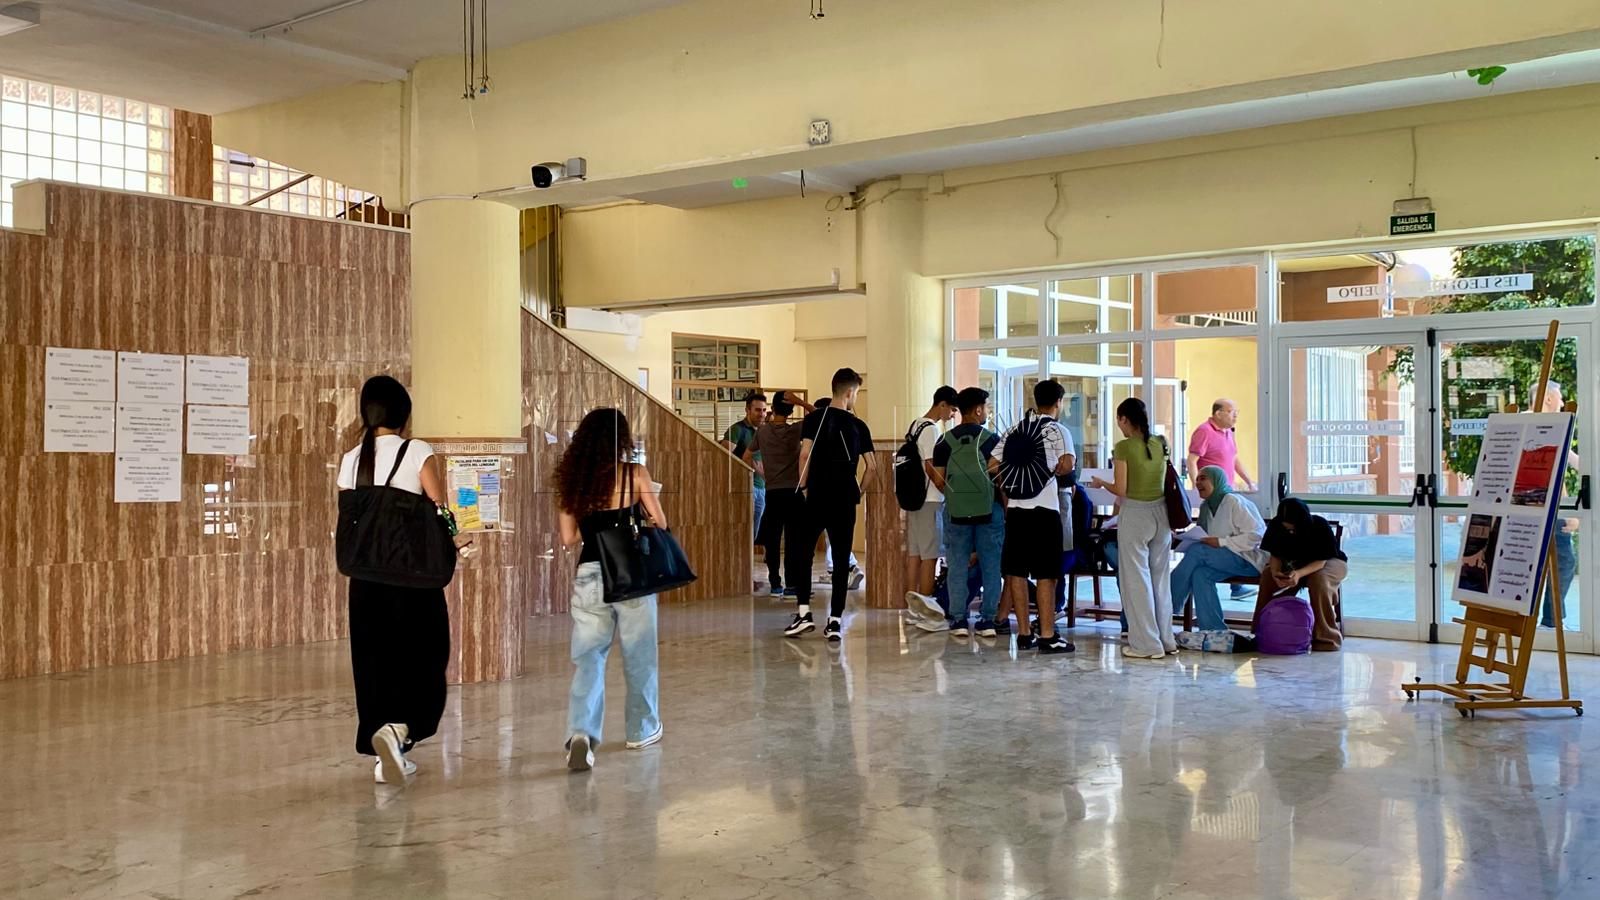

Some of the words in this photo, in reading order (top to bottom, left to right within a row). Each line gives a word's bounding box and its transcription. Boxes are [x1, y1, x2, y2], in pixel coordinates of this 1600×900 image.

[1396, 216, 1419, 225] SALIDA
[1419, 215, 1429, 223] DE
[1392, 223, 1433, 233] EMERGENCIA
